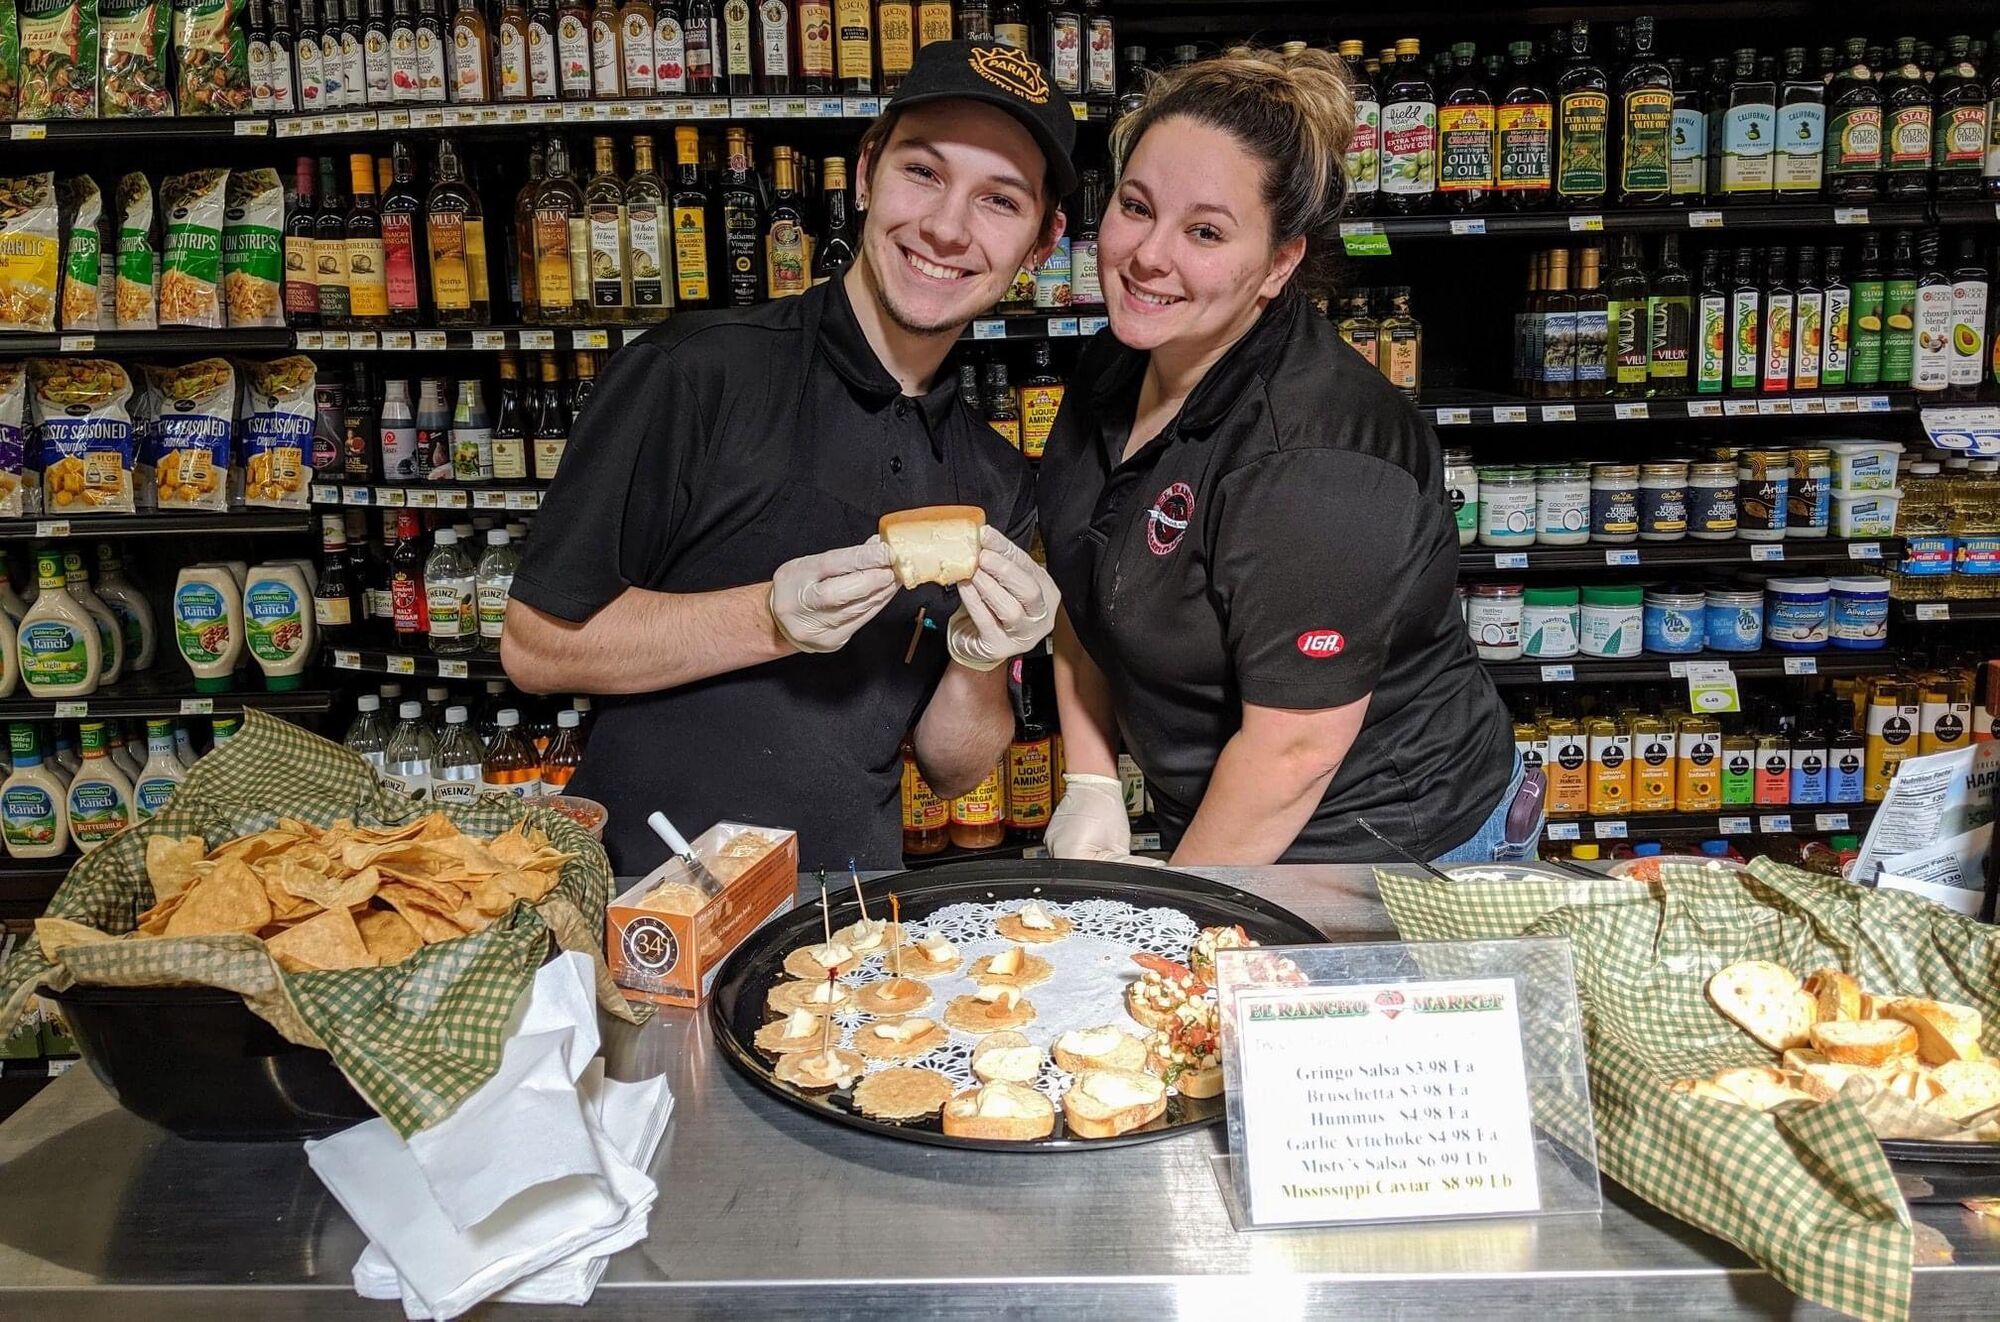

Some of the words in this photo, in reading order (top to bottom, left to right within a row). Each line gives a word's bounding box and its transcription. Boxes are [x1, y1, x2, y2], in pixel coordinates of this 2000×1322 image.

[734, 42, 742, 51] 4
[773, 43, 780, 52] 4
[988, 60, 1035, 90] PARMA
[1571, 99, 1602, 107] CENTO
[1636, 96, 1668, 104] CENTO
[1564, 116, 1584, 124] EXTRA
[1630, 114, 1648, 122] EXTRA
[1738, 112, 1770, 122] CALIFORNIA
[1788, 111, 1820, 120] CALIFORNIA
[1851, 112, 1879, 124] STAR
[1901, 112, 1928, 124] STAR
[1957, 111, 1984, 122] STAR
[1568, 123, 1588, 131] OLIVE
[1957, 128, 1983, 136] EXTRA
[1852, 130, 1878, 138] EXTRA
[1900, 129, 1928, 138] EXTRA
[1957, 134, 1983, 142] VIRGIN
[1388, 138, 1408, 146] EXTRA
[1410, 135, 1433, 144] VIRGIN
[1852, 136, 1879, 144] VIRGIN
[1901, 136, 1928, 144] VIRGIN
[1448, 154, 1489, 165] OLIVE
[1507, 153, 1547, 164] OLIVE
[1458, 166, 1480, 176] OIL
[1517, 165, 1538, 175] OIL
[381, 214, 410, 226] VILUX
[430, 214, 462, 226] VILUX
[536, 210, 566, 223] VILUX
[728, 232, 756, 240] Balsamic
[179, 233, 216, 251] STRIPS
[237, 233, 276, 252] STRIPS
[731, 241, 754, 250] Vinegar
[1346, 242, 1388, 251] Organic
[1922, 310, 1950, 318] chosen
[1925, 316, 1946, 325] blend
[1964, 316, 1974, 324] oil
[1828, 299, 1841, 362] AVOCADO
[1658, 350, 1686, 360] VILUX
[1626, 355, 1646, 366] VILU
[1032, 408, 1056, 416] LIQUID
[70, 422, 126, 440] SEASONED
[108, 454, 120, 462] OFF
[196, 452, 211, 460] OFF
[40, 563, 52, 572] 60
[40, 579, 57, 588] Light
[272, 594, 289, 602] Valley
[430, 589, 454, 598] HEINZ
[480, 590, 502, 598] HEINZ
[184, 606, 216, 617] Ranch
[254, 604, 288, 616] Ranch
[395, 614, 418, 622] VINEGAR
[1664, 618, 1683, 627] VITA
[1738, 617, 1756, 625] VITA
[33, 639, 67, 650] Ranch
[1304, 634, 1336, 650] IGA
[42, 662, 62, 670] Light
[1018, 766, 1046, 776] LIQUID
[1013, 775, 1049, 786] AMINOS
[1900, 774, 1932, 785] Nutrition
[440, 787, 470, 796] HEINZ
[976, 786, 998, 795] CIDER
[79, 798, 112, 808] Ranch
[963, 794, 992, 803] VINEGAR
[1932, 794, 1946, 803] 130
[9, 804, 45, 815] Ranch
[78, 822, 122, 832] BUTTERMILK
[1931, 856, 1955, 866] Facts
[1942, 874, 1961, 884] 130
[1249, 1003, 1274, 1019] EL
[1278, 1000, 1369, 1017] RANCHO
[1413, 994, 1504, 1011] MARKET
[1296, 1064, 1353, 1081] Gringo
[1359, 1063, 1400, 1077] Salsa
[1308, 1086, 1394, 1104] Bruschetta
[1312, 1112, 1385, 1126] Hummus
[1286, 1136, 1337, 1151] Garlic
[1346, 1131, 1423, 1149] Artichoke
[1302, 1158, 1360, 1174] Misty's
[1366, 1156, 1407, 1172] Salsa
[1282, 1183, 1370, 1199] Mississippi
[1376, 1180, 1432, 1194] Caviar
